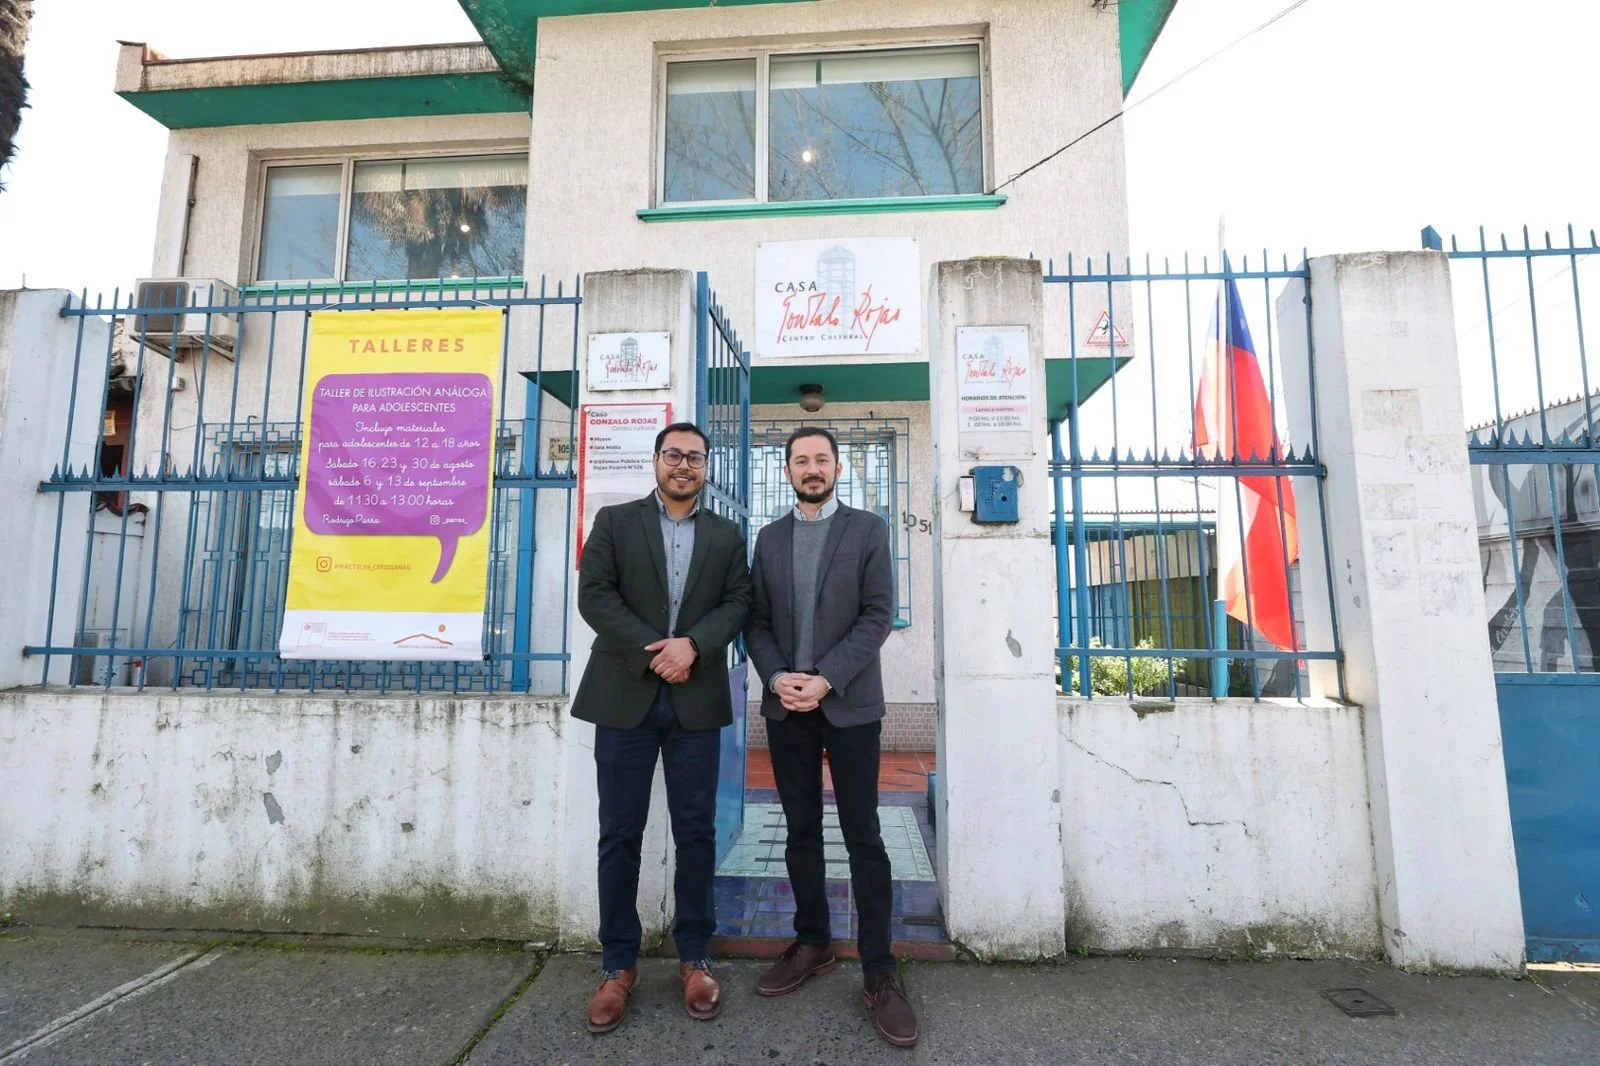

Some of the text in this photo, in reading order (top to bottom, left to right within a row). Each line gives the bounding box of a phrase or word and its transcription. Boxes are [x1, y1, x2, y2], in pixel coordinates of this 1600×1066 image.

[774, 281, 817, 293] CASA
[851, 283, 901, 351] Rojas
[349, 338, 464, 353] TALLERES
[320, 385, 487, 398] TALLER DE ILUSTRACIÓN ANÁLOGA
[352, 402, 456, 413] PARA ADOLESCENTES
[356, 421, 446, 436] Incluye materiales
[318, 442, 339, 453] para
[342, 438, 399, 448] adolescentes
[400, 438, 411, 448] de
[414, 437, 429, 448] 12
[441, 437, 455, 448] 18
[456, 440, 481, 448] años
[400, 462, 408, 473] y
[412, 457, 428, 468] 30
[429, 459, 440, 468] de
[443, 459, 475, 473] agosto
[328, 475, 467, 491] sábado 6 y 13 de septiembre
[333, 495, 345, 505] de
[425, 495, 455, 506] horas
[322, 514, 381, 527] Rodrigo Parra
